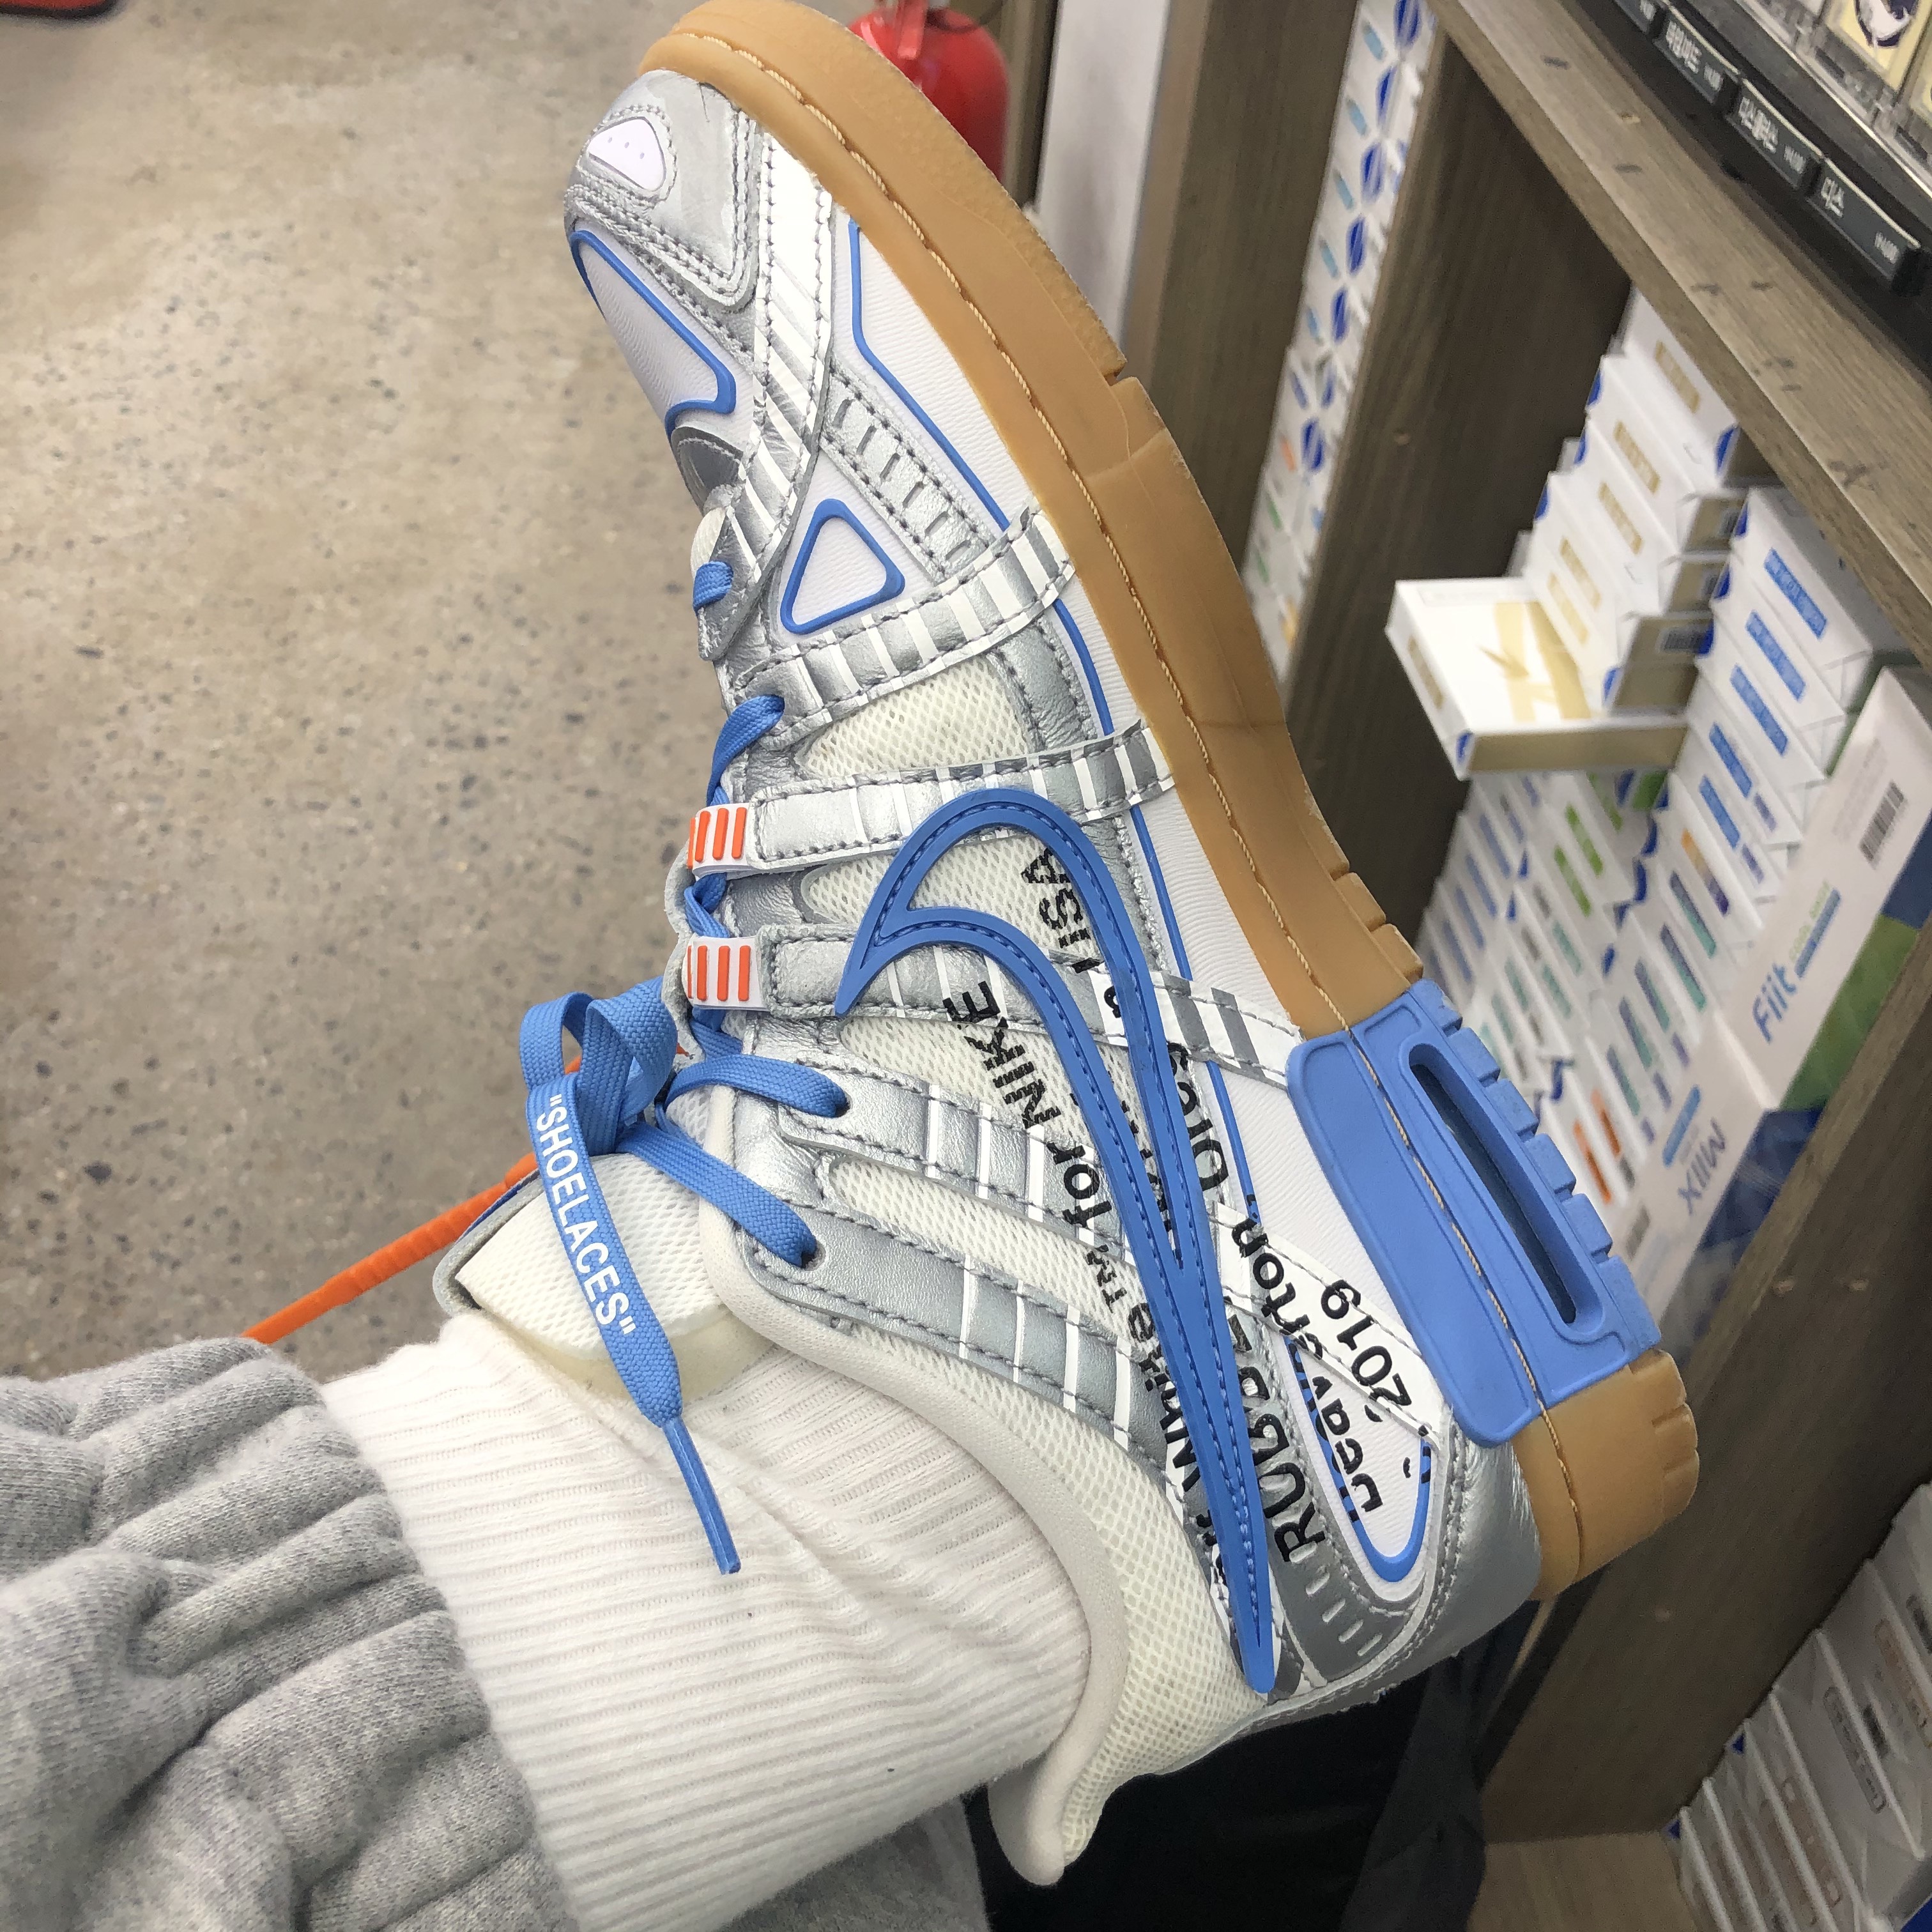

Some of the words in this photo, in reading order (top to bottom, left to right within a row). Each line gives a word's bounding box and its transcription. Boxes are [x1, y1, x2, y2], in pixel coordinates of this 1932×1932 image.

[1021, 847, 1105, 974] USA
[942, 980, 1061, 1130] NIKE
[535, 1093, 636, 1335] "SHOELACES"
[1046, 1141, 1112, 1228] for
[1319, 1278, 1413, 1423] 2019
[1225, 1296, 1326, 1563] RUBB
